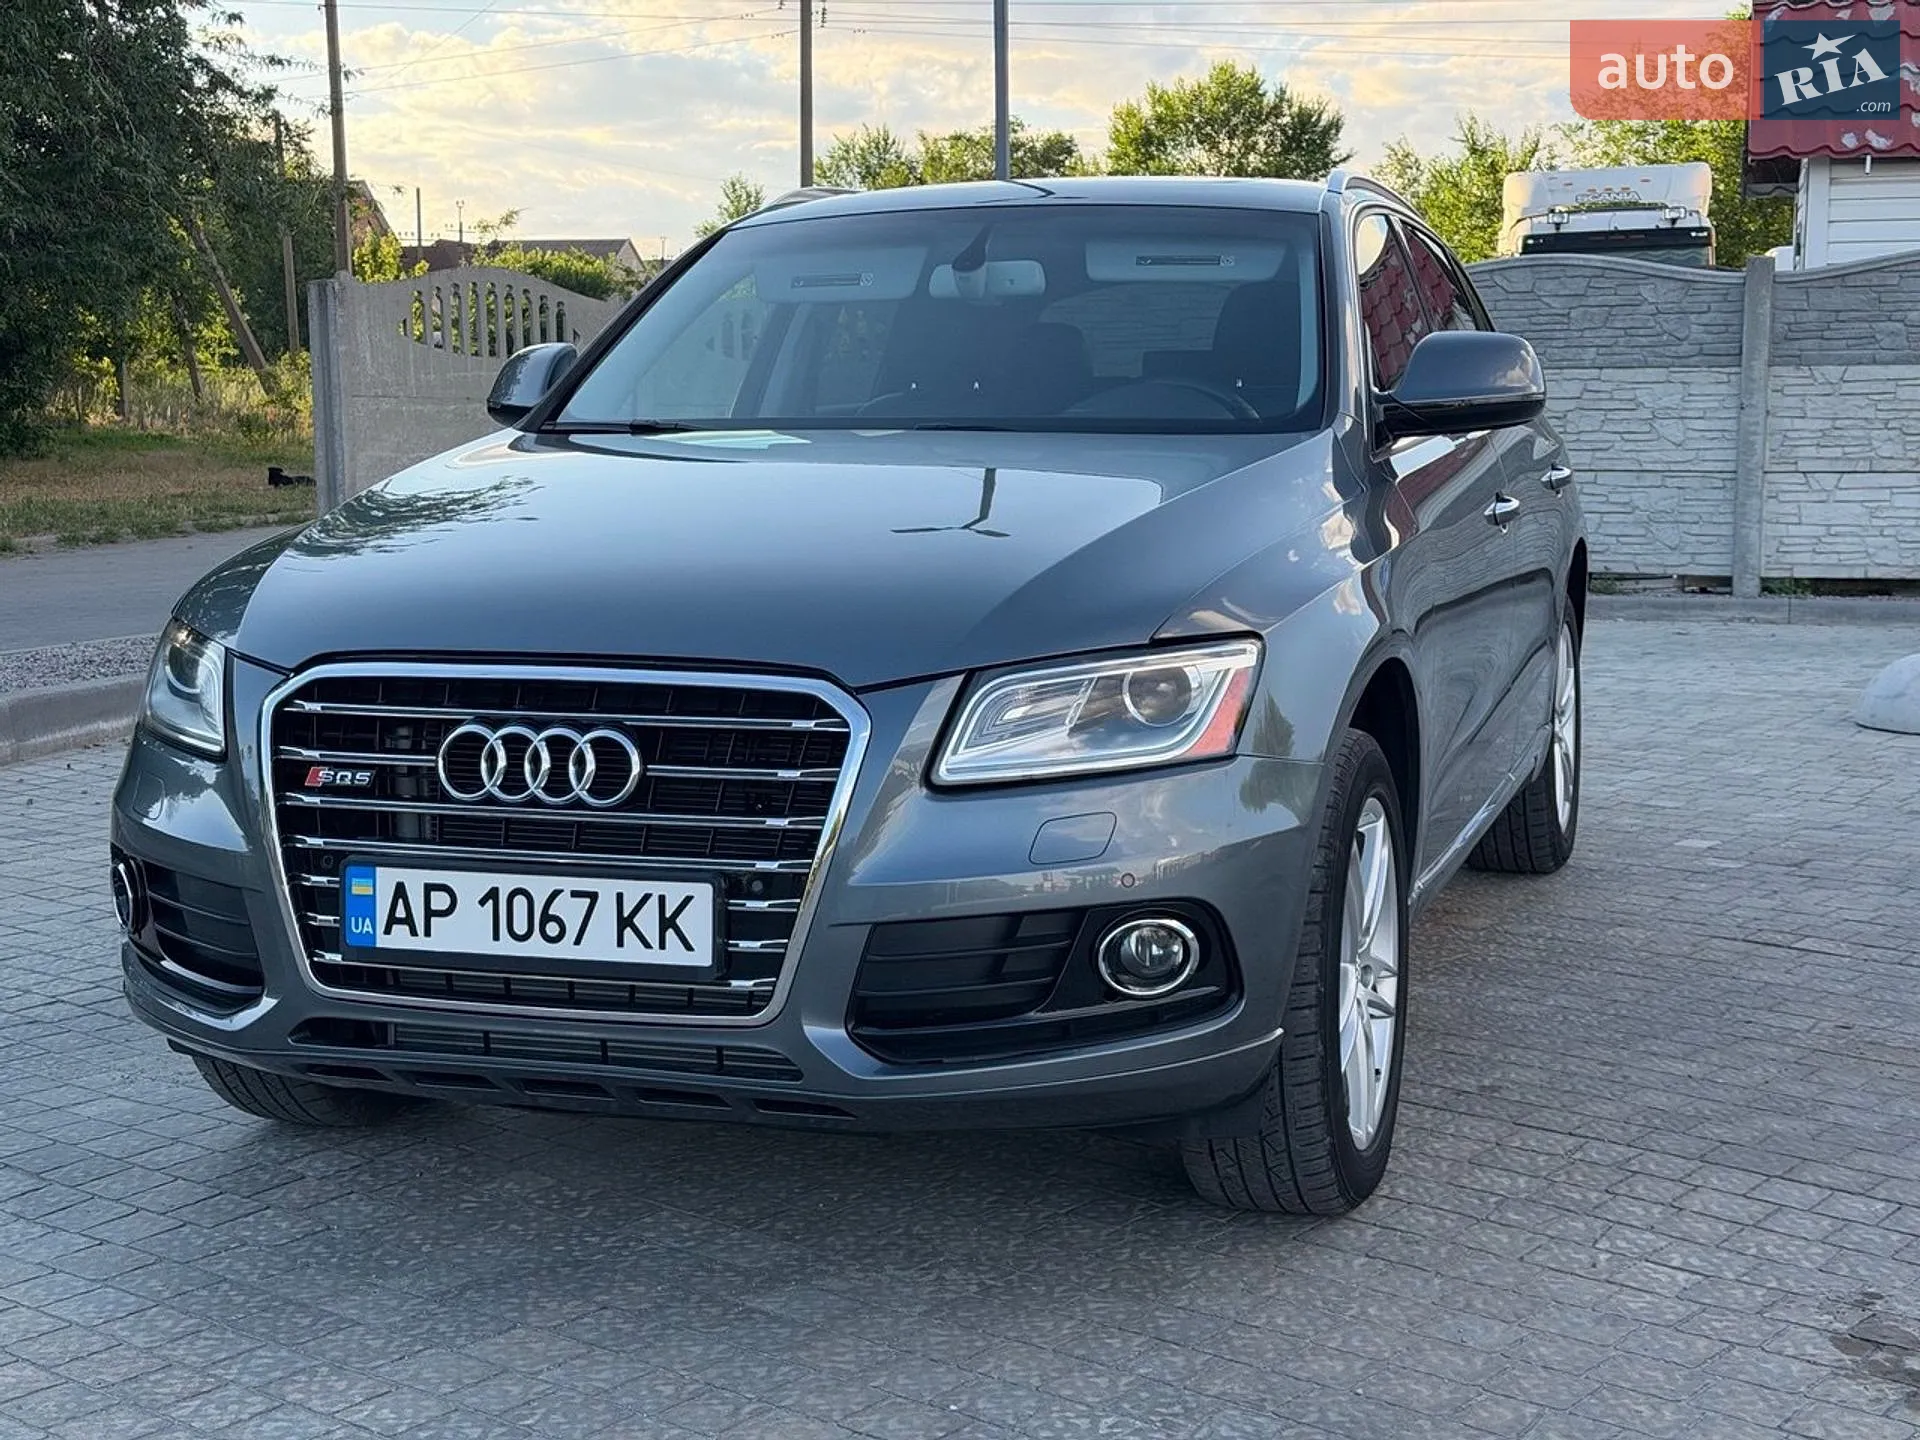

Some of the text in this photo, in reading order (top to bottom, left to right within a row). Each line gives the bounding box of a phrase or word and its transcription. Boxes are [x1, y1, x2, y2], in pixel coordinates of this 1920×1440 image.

[318, 770, 371, 785] SQ5
[351, 916, 374, 935] UA
[383, 881, 696, 952] AP 1067 KK
